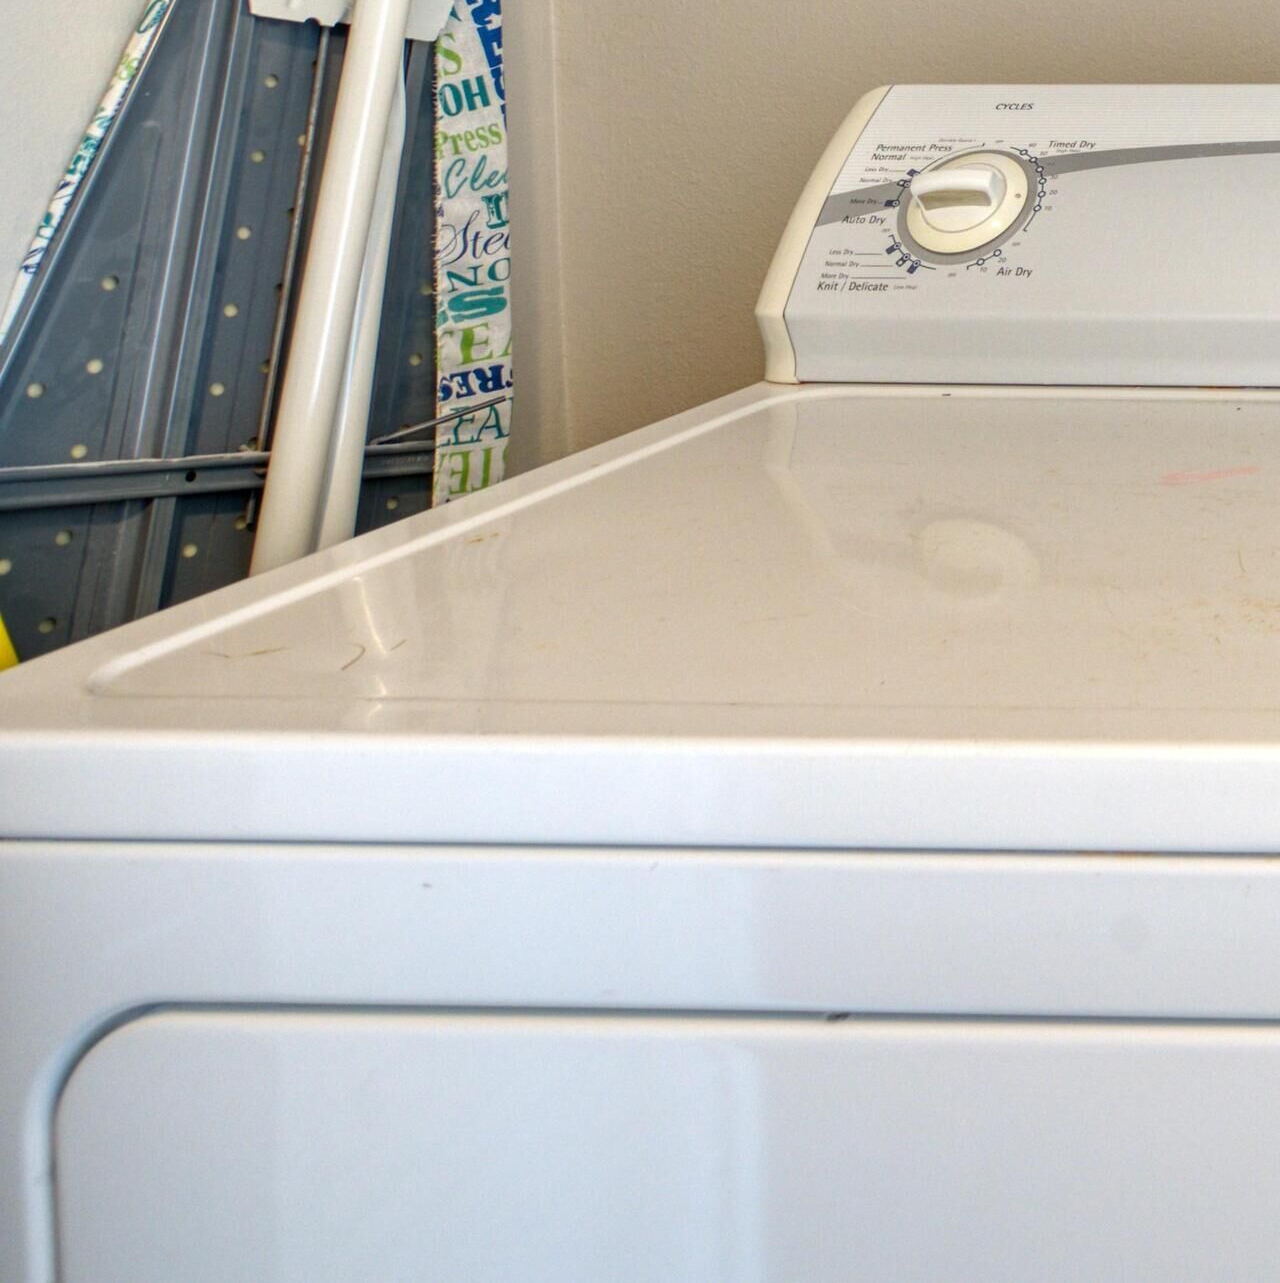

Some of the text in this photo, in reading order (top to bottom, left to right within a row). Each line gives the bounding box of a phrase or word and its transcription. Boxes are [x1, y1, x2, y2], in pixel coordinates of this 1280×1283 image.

[435, 123, 503, 159] Press
[1049, 140, 1096, 150] Timed Dry
[876, 144, 952, 152] Permanent Press
[840, 216, 886, 226] Auto Dry
[996, 267, 1032, 278] Air Dry
[817, 281, 838, 291] Knit
[848, 281, 888, 292] Delicate
